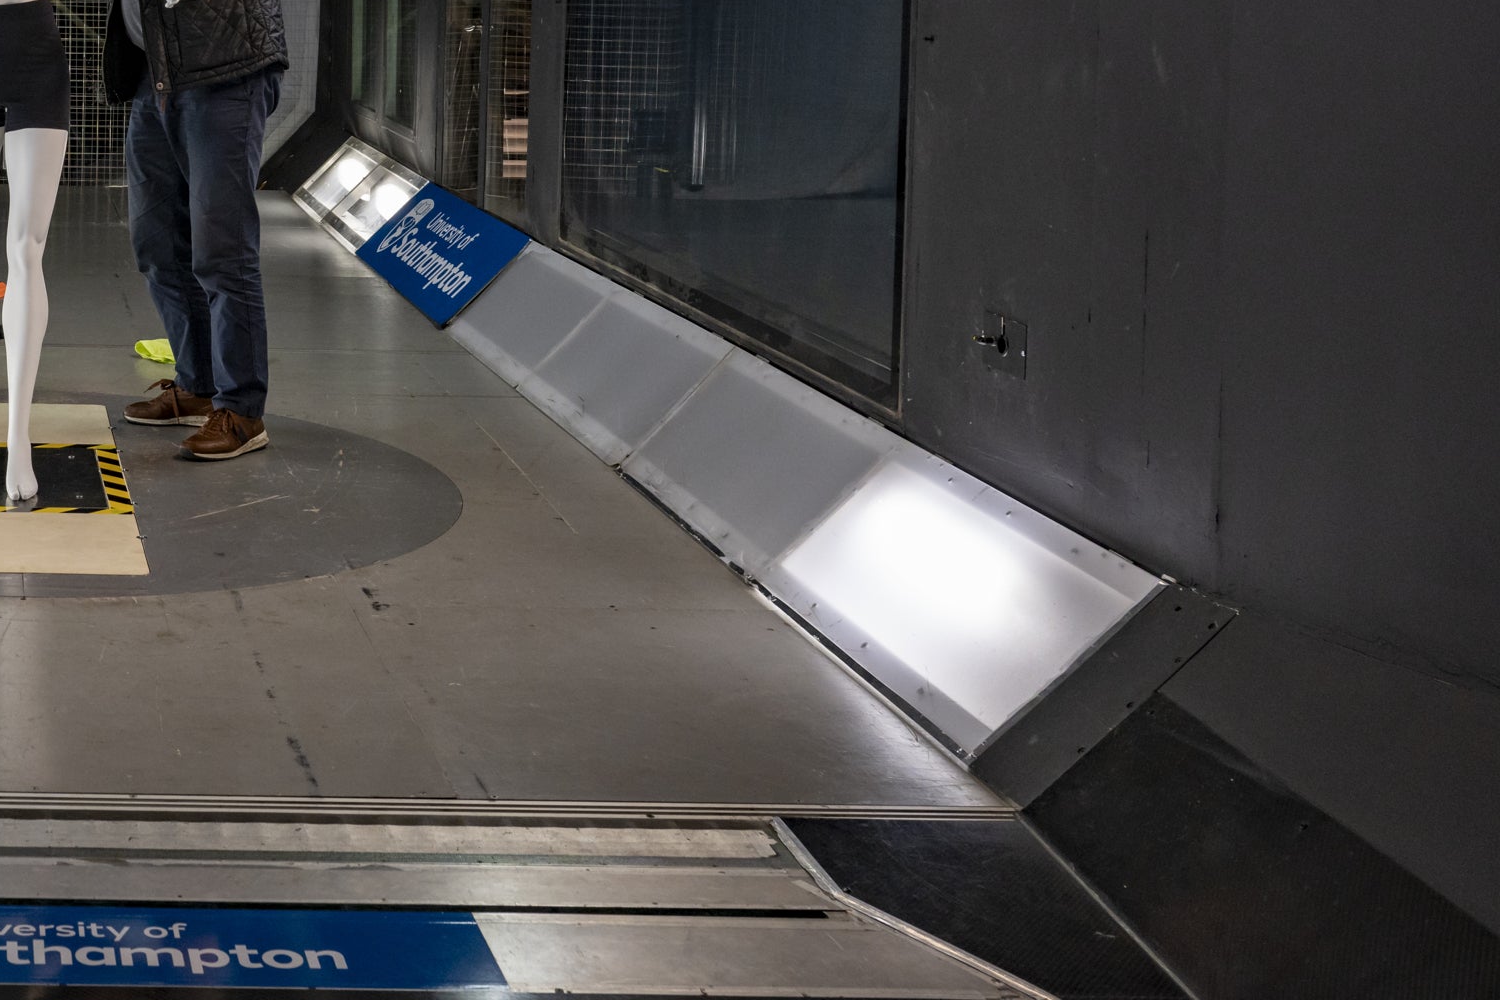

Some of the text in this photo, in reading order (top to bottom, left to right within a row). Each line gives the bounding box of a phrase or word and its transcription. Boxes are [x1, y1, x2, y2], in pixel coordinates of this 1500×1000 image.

[426, 212, 480, 250] University of
[391, 227, 472, 299] Southampton
[143, 922, 187, 939] of
